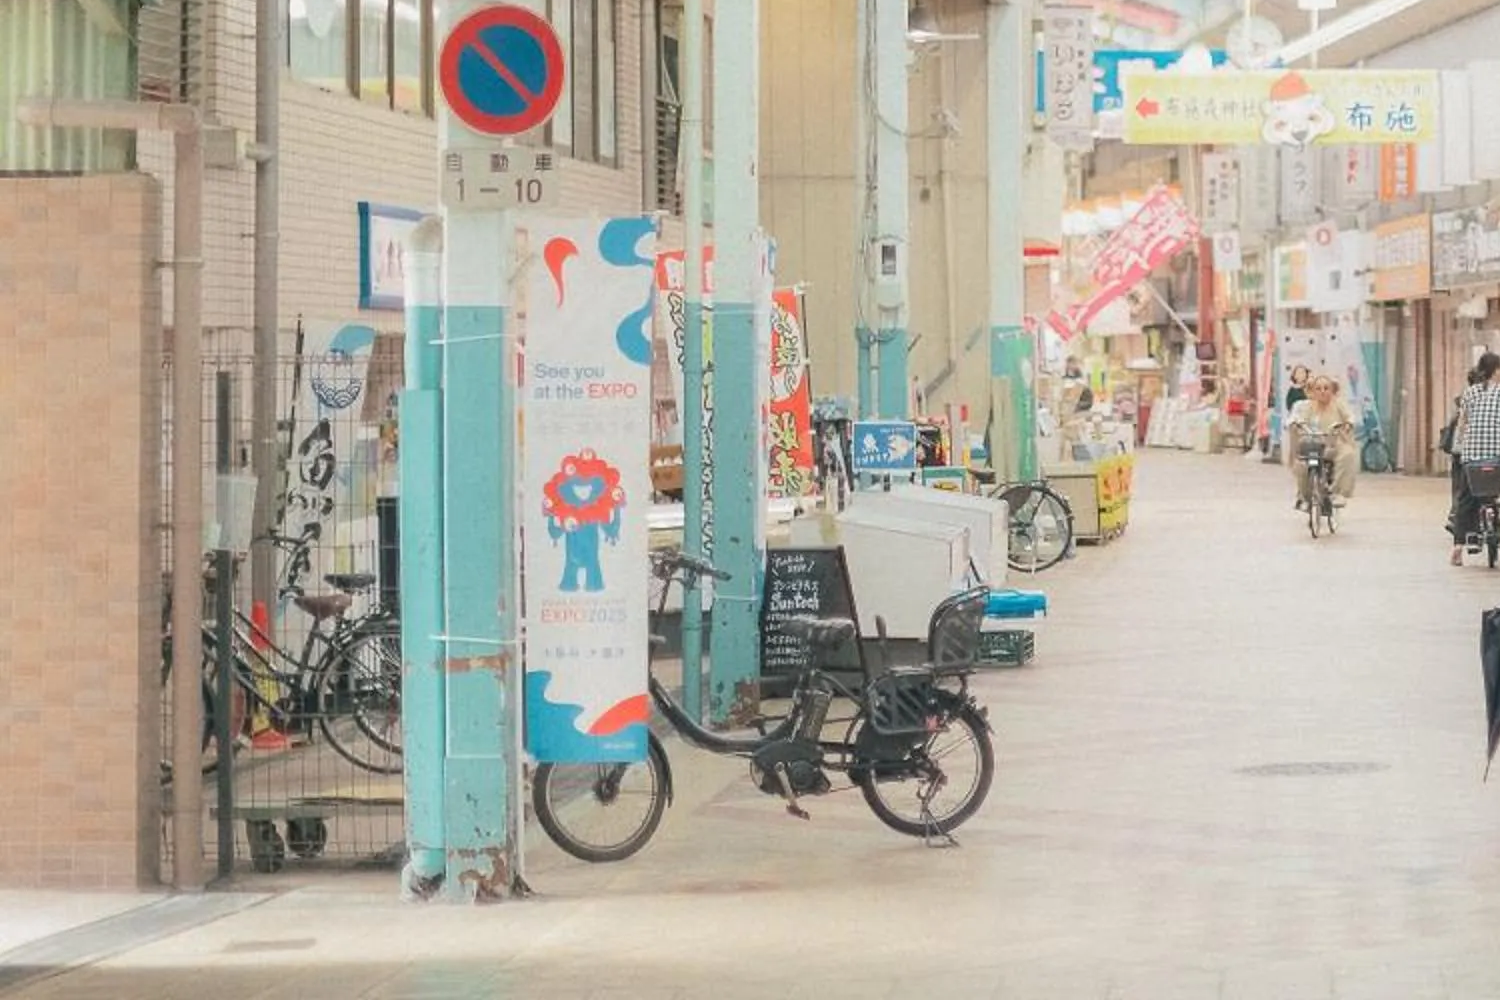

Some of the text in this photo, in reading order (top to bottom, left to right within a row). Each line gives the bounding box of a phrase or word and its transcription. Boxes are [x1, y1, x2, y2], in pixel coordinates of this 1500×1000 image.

[1346, 102, 1416, 131] 布施
[446, 153, 552, 172] 自動車
[535, 363, 605, 382] See you
[534, 383, 637, 399] at the EXPO
